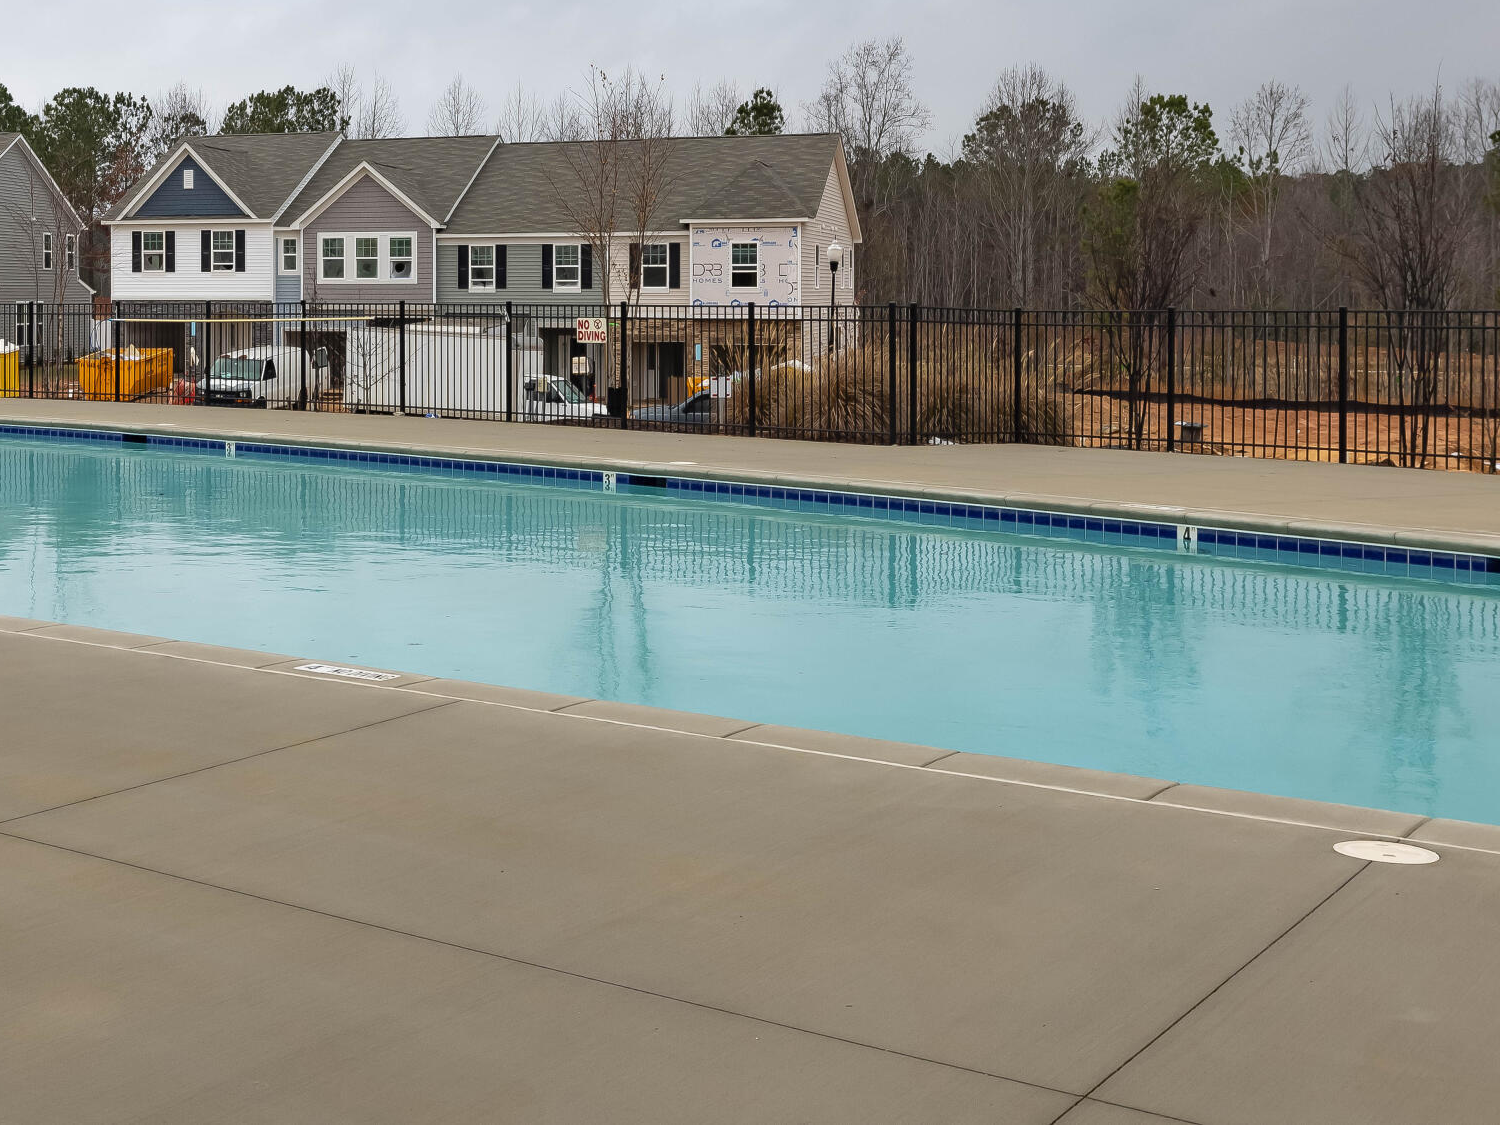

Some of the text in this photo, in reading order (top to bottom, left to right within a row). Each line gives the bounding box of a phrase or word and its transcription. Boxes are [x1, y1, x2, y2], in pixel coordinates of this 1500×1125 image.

[692, 263, 723, 277] DRB
[577, 319, 590, 330] NO
[577, 330, 606, 342] DIVING
